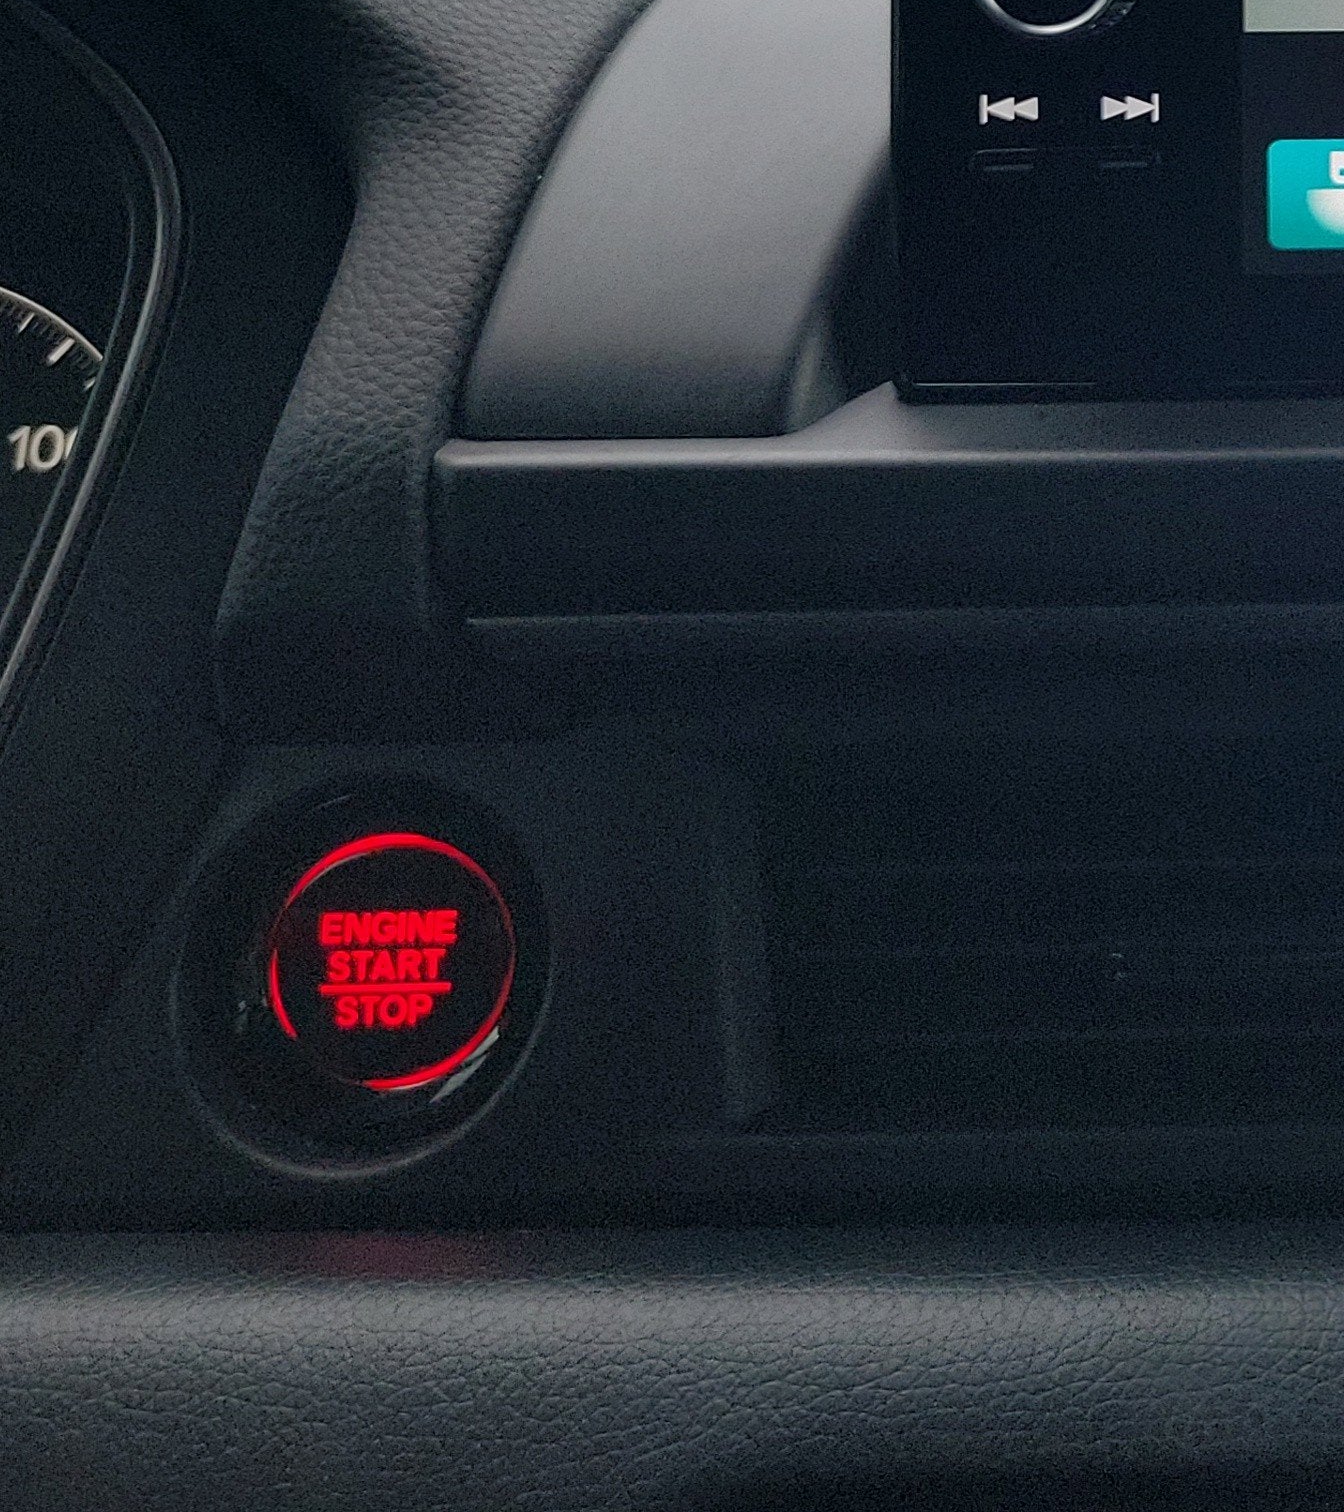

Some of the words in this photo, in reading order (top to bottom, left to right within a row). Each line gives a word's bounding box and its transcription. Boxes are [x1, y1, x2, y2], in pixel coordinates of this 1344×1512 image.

[320, 910, 458, 944] ENGINE
[328, 950, 446, 980] START
[335, 995, 433, 1027] STOP
